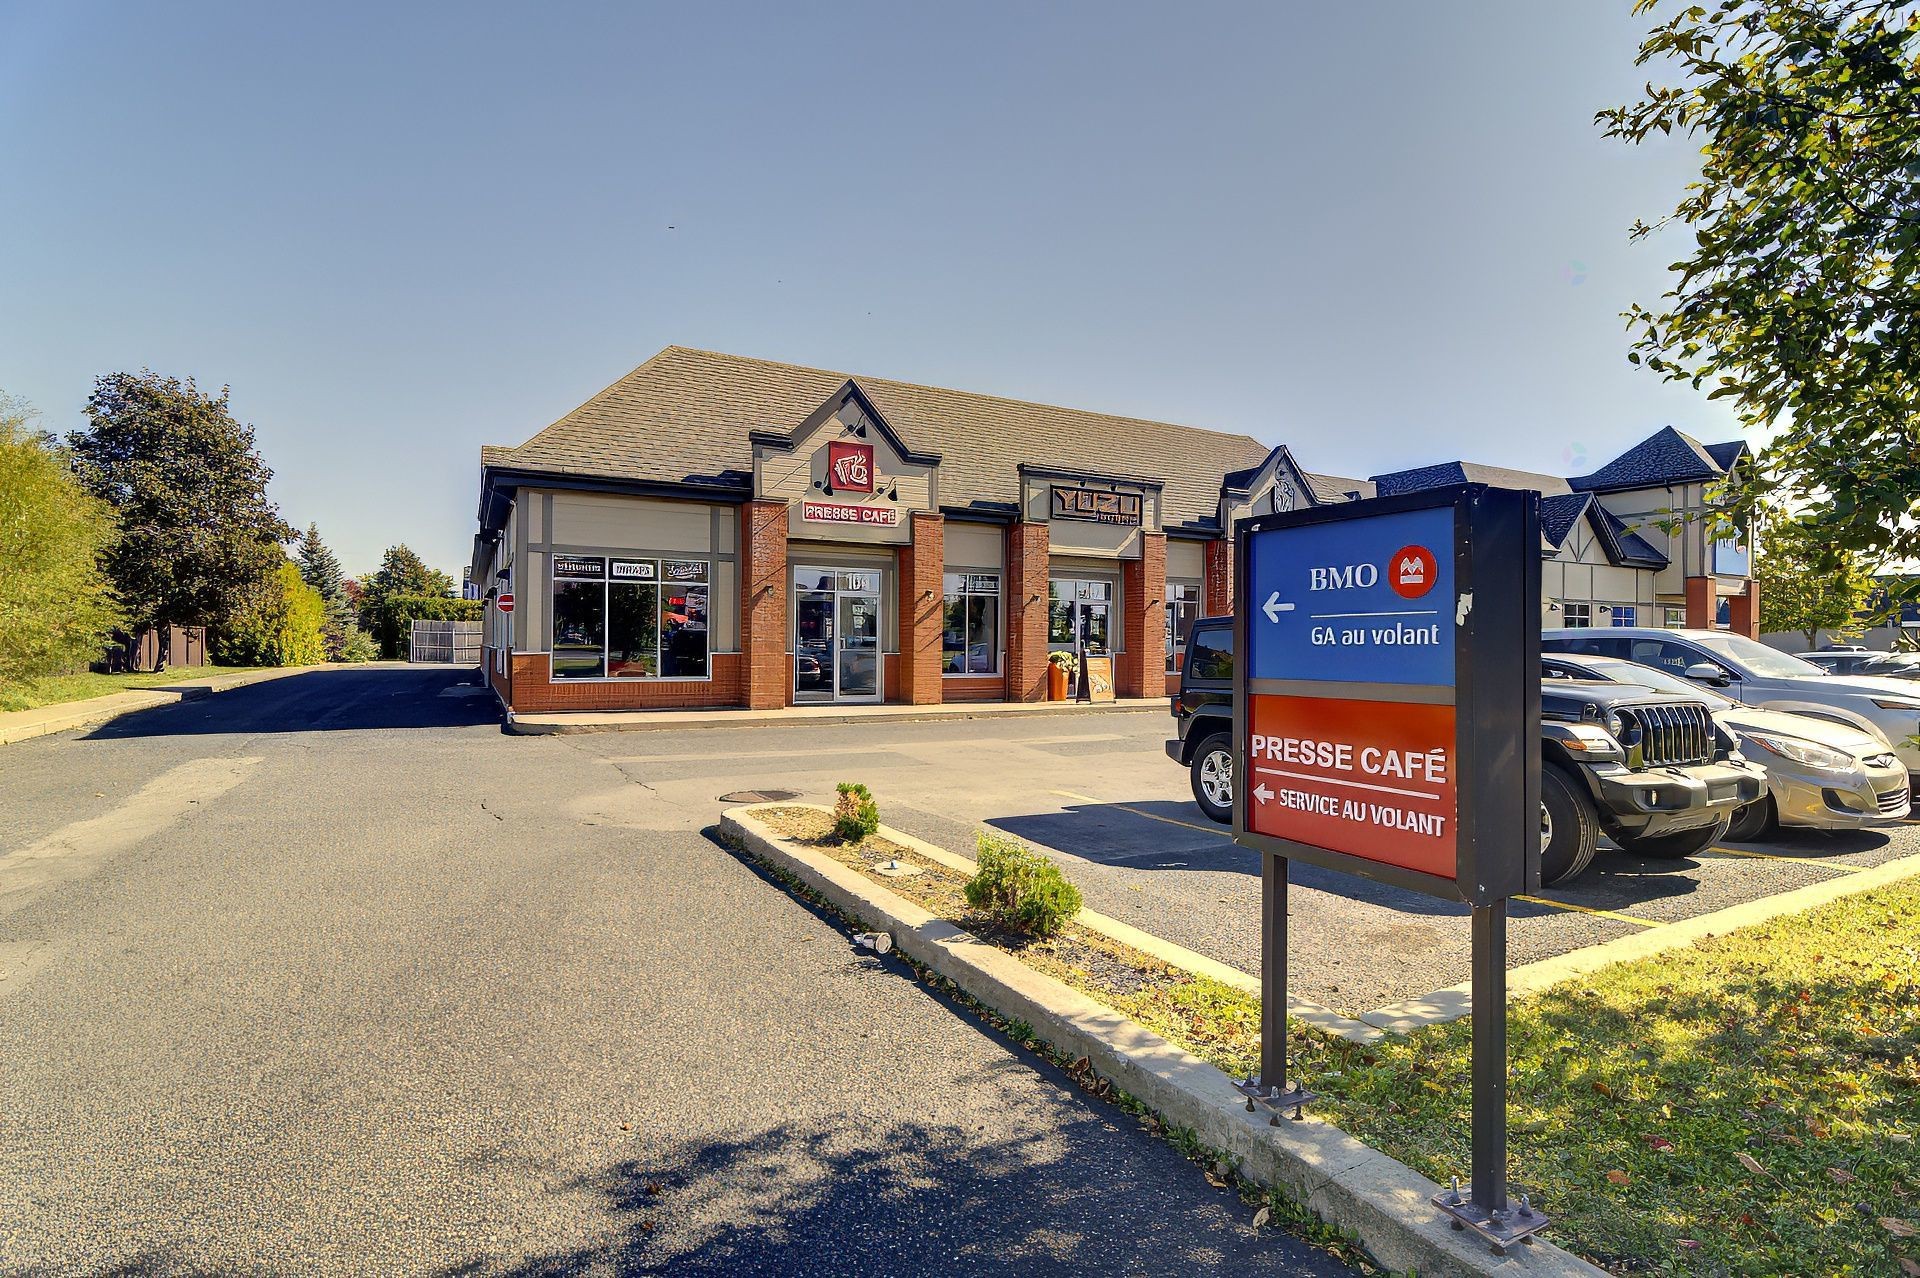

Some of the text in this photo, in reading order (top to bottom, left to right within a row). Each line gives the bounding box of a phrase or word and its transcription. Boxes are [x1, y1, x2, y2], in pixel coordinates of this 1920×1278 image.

[806, 505, 896, 524] PRESSE CAFÉ
[1310, 564, 1378, 591] BMO
[1311, 623, 1440, 645] GA au volant
[1251, 734, 1446, 784] PRESSE CAFÉ
[1279, 788, 1446, 837] SERVICE AU VOLANT
